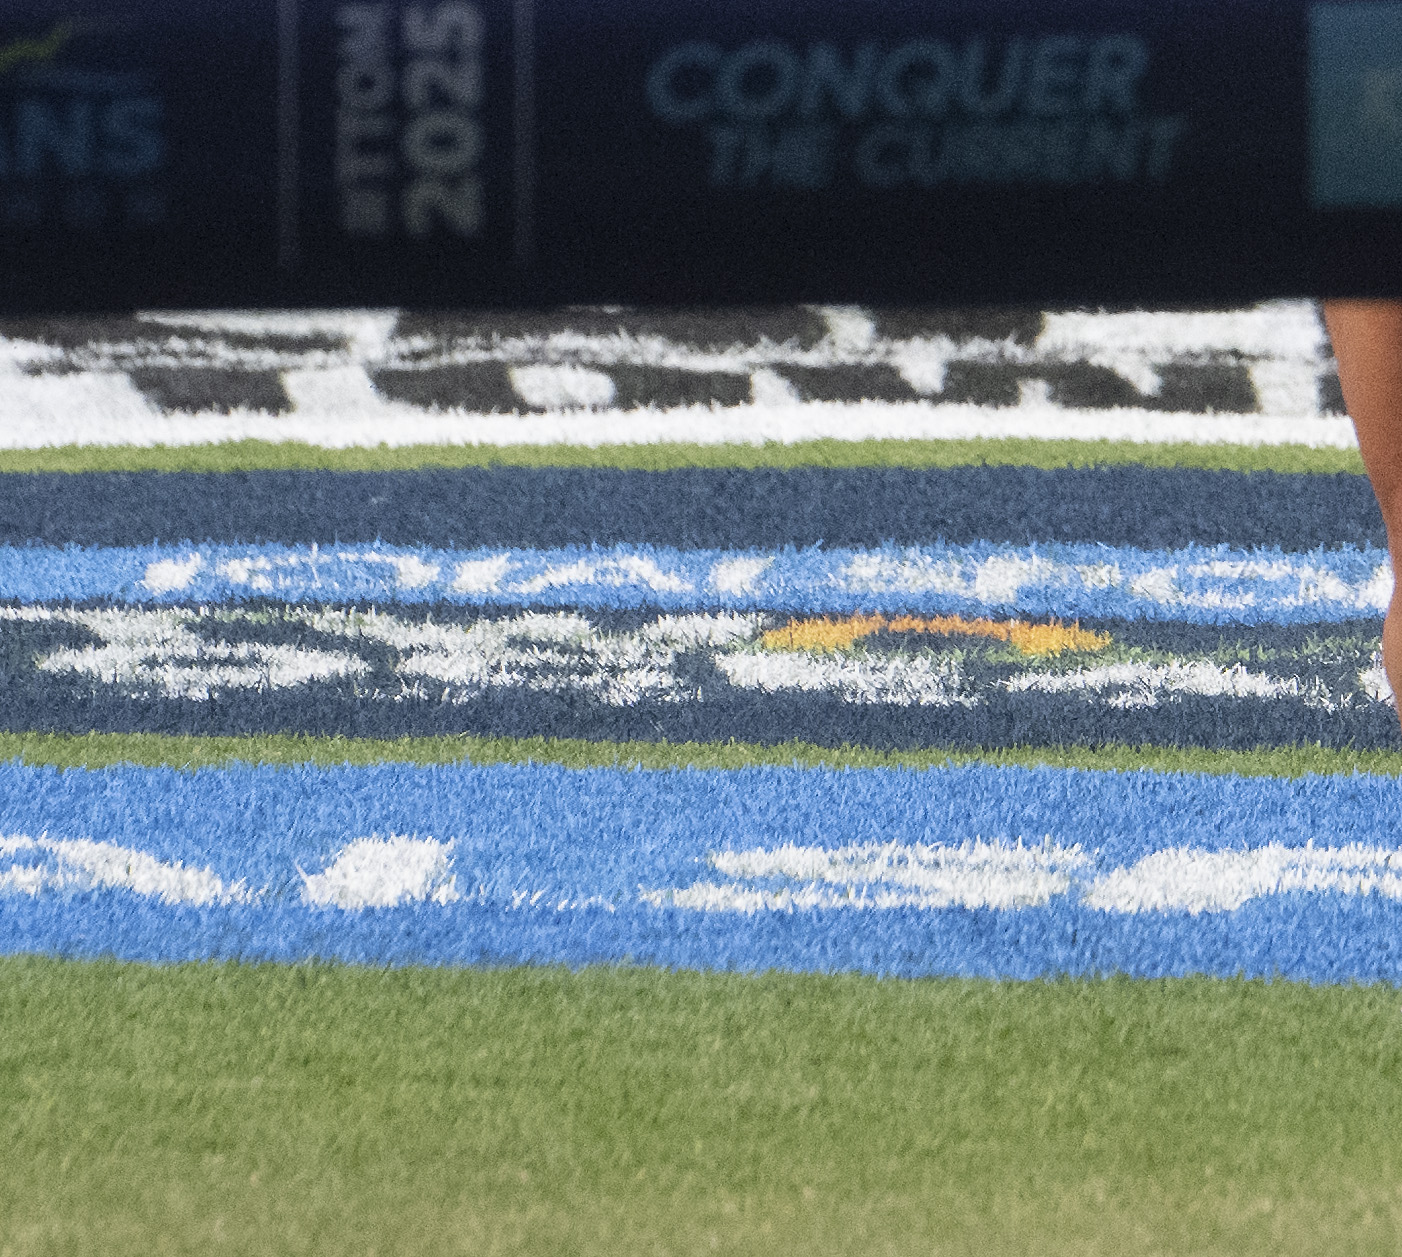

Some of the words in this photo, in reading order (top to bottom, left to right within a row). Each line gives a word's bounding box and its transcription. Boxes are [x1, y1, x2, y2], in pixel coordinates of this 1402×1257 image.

[644, 32, 1150, 124] CONQUER
[0, 94, 167, 177] NS
[706, 120, 833, 190] THE
